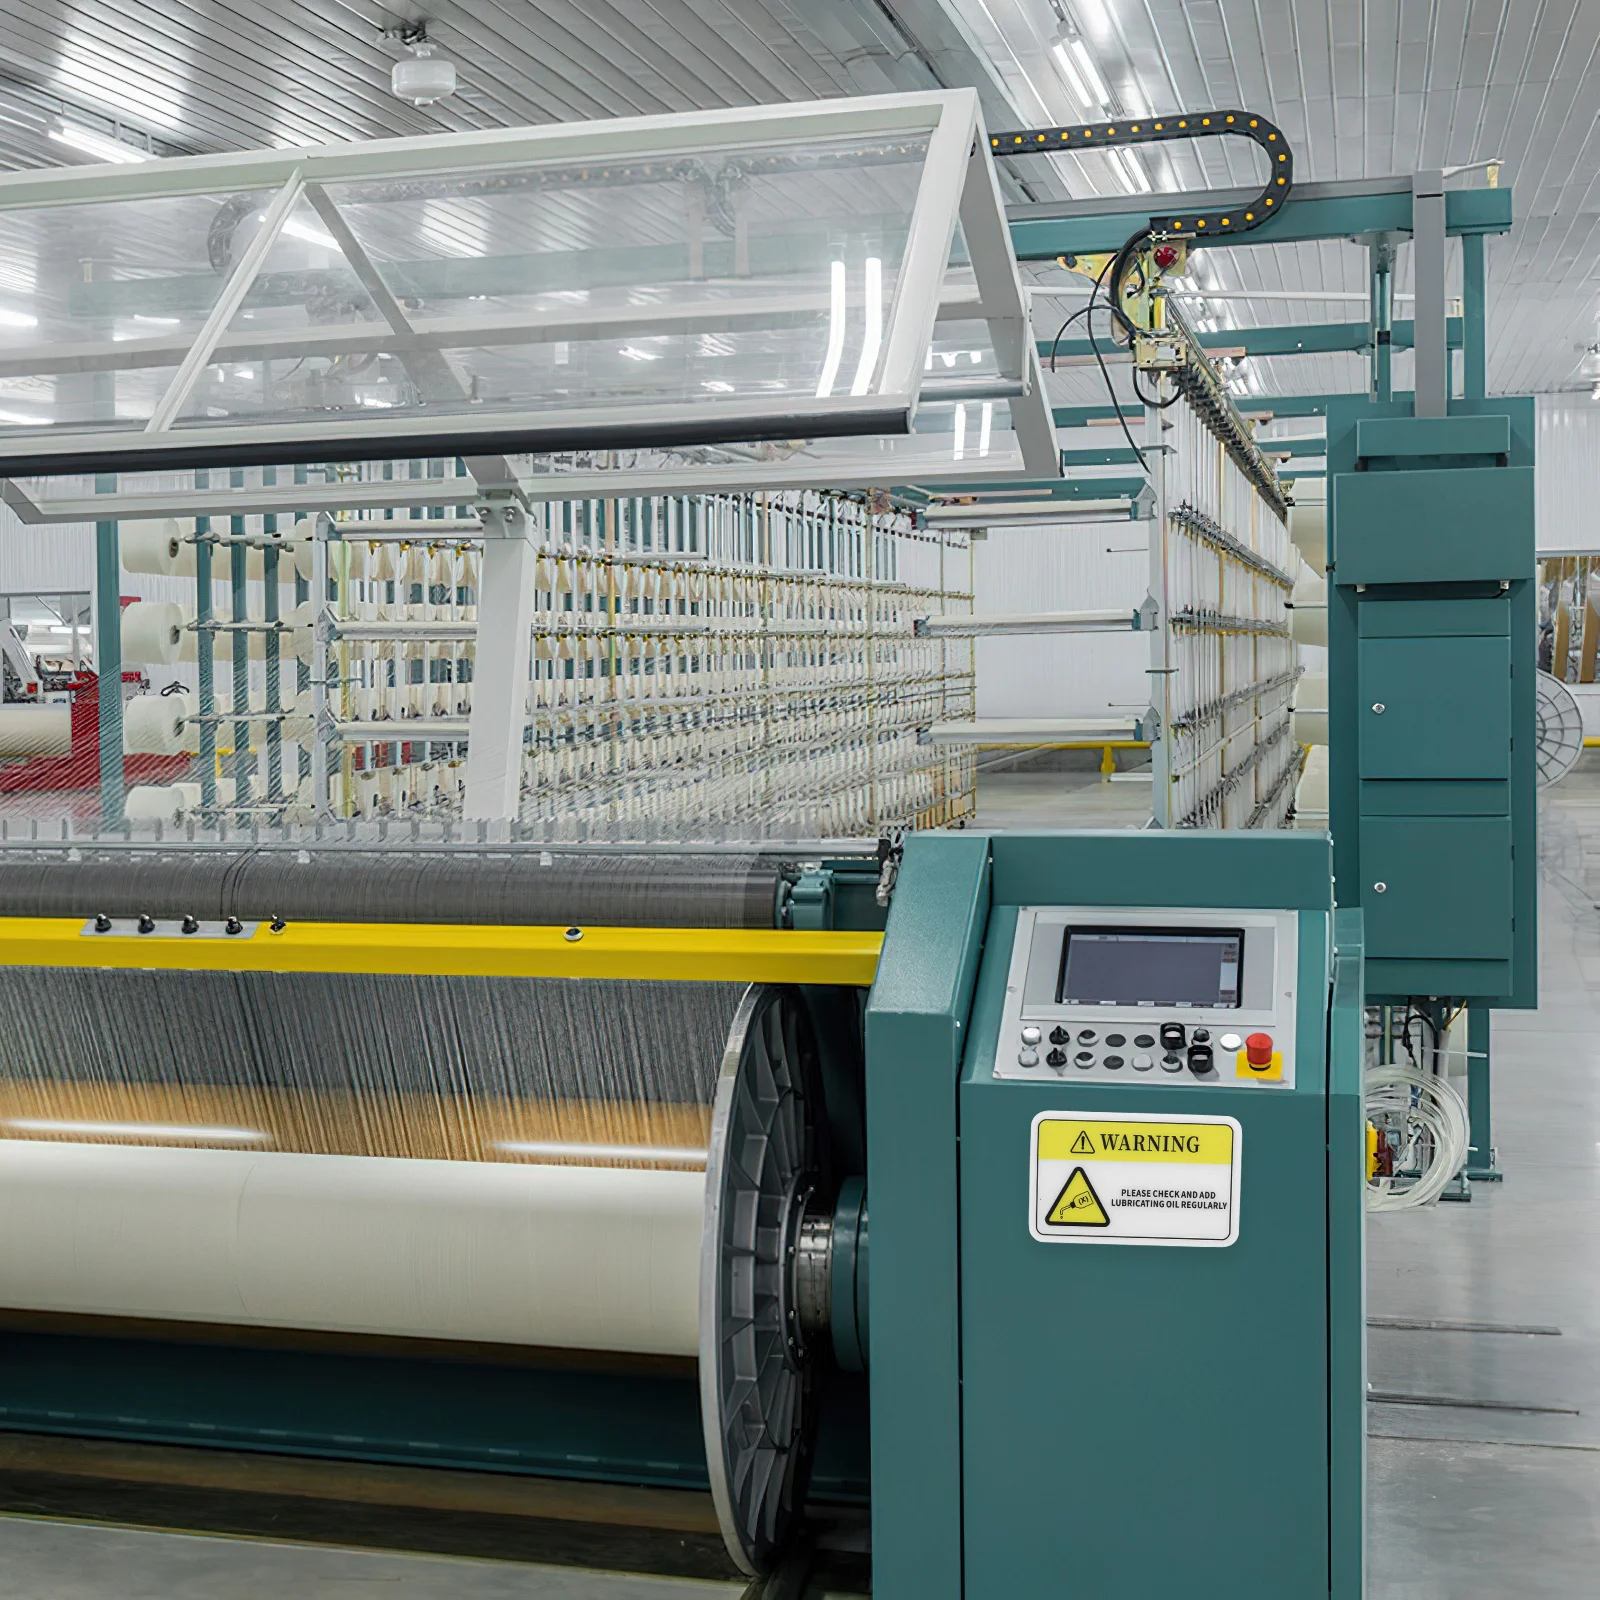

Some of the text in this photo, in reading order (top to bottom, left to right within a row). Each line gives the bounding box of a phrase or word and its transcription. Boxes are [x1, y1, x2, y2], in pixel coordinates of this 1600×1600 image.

[1100, 1134, 1200, 1153] WARNING
[1121, 1189, 1216, 1200] PLEASE CHECK AND ADD
[1111, 1199, 1227, 1210] LUBRICATING OIL REGULARLY
